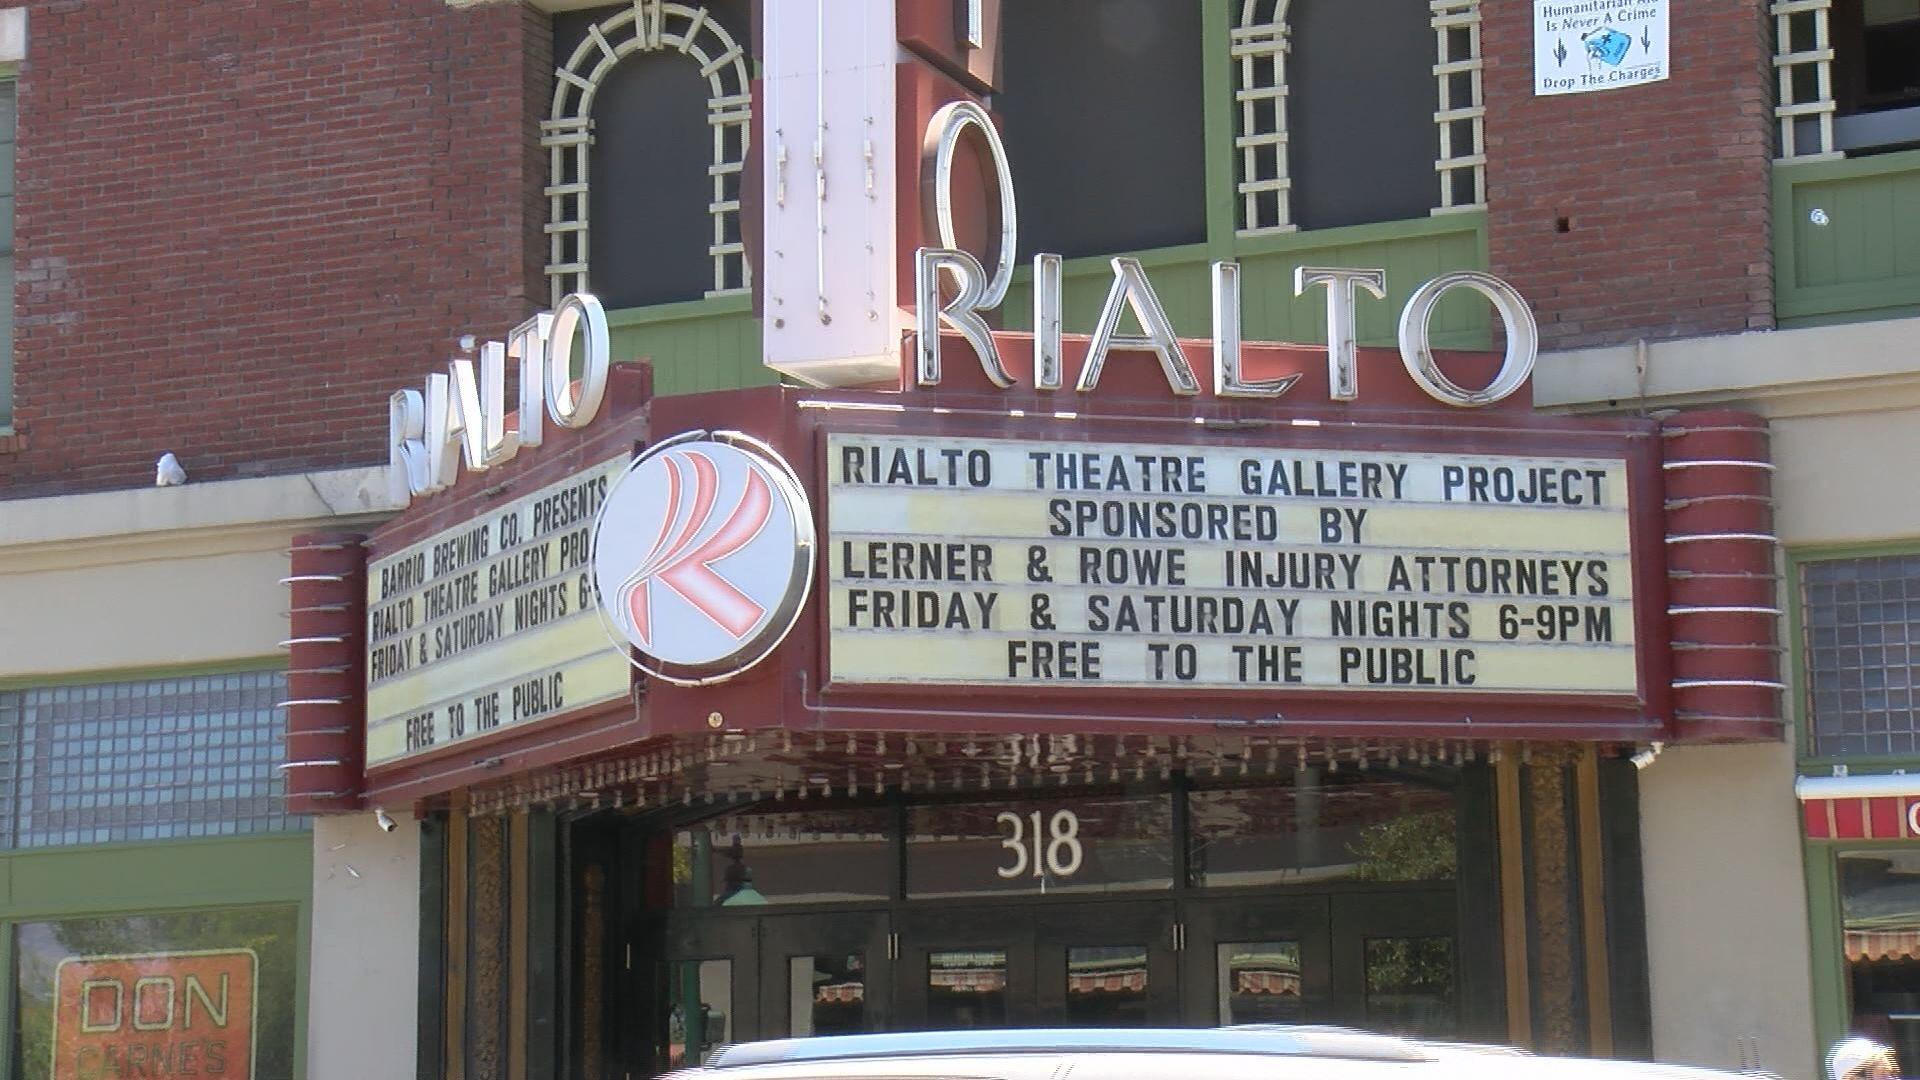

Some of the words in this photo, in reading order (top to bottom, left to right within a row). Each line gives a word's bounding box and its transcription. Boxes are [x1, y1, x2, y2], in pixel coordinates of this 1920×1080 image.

[1543, 0, 1632, 17] Humanitarian
[1546, 20, 1557, 31] Is
[1562, 17, 1599, 30] Never
[1604, 13, 1612, 23] A
[1618, 8, 1656, 21] Crime
[1543, 77, 1575, 89] Drop
[1580, 74, 1604, 85] The
[1609, 65, 1661, 81] Charges
[915, 247, 1539, 408] RIALTO
[390, 293, 609, 508] RIALTO
[843, 446, 990, 488] RIALTO
[1029, 452, 1206, 493] THEATRE
[1240, 459, 1408, 499] GALLERY
[1443, 465, 1607, 505] PROJECT
[382, 553, 424, 599] BARRIO
[433, 524, 489, 569] BREWING
[500, 513, 522, 550] CO.
[533, 475, 607, 537] PRESENTS
[1050, 499, 1277, 541] SPONSORED
[1320, 507, 1368, 544] BY
[373, 597, 414, 642] RIALTO
[423, 572, 479, 619] THEATRE
[489, 543, 549, 596] GALLERY
[843, 541, 993, 581] LERNER
[1027, 545, 1053, 582] &
[1080, 546, 1187, 586] ROWE
[1226, 551, 1362, 590] INJURY
[1387, 555, 1609, 597] ATTORNEYS
[371, 639, 413, 682] FRIDAY
[419, 634, 428, 663] &
[436, 604, 504, 659] SATURDAY
[515, 582, 568, 631] NIGHTS
[849, 589, 998, 629] FRIDAY
[1030, 594, 1057, 630] &
[1088, 595, 1300, 635] SATURDAY
[1331, 600, 1470, 640] NIGHTS
[1500, 604, 1612, 642] 6-9PM
[1008, 640, 1101, 679] FREE
[1148, 644, 1197, 681] TO
[1232, 645, 1302, 683] THE
[1340, 647, 1476, 685] PUBLIC
[406, 711, 434, 751] FREE
[448, 706, 464, 737] TO
[475, 691, 499, 731] THE
[513, 671, 564, 720] PUBLIC
[996, 809, 1083, 878] 318
[82, 973, 229, 1032] DON
